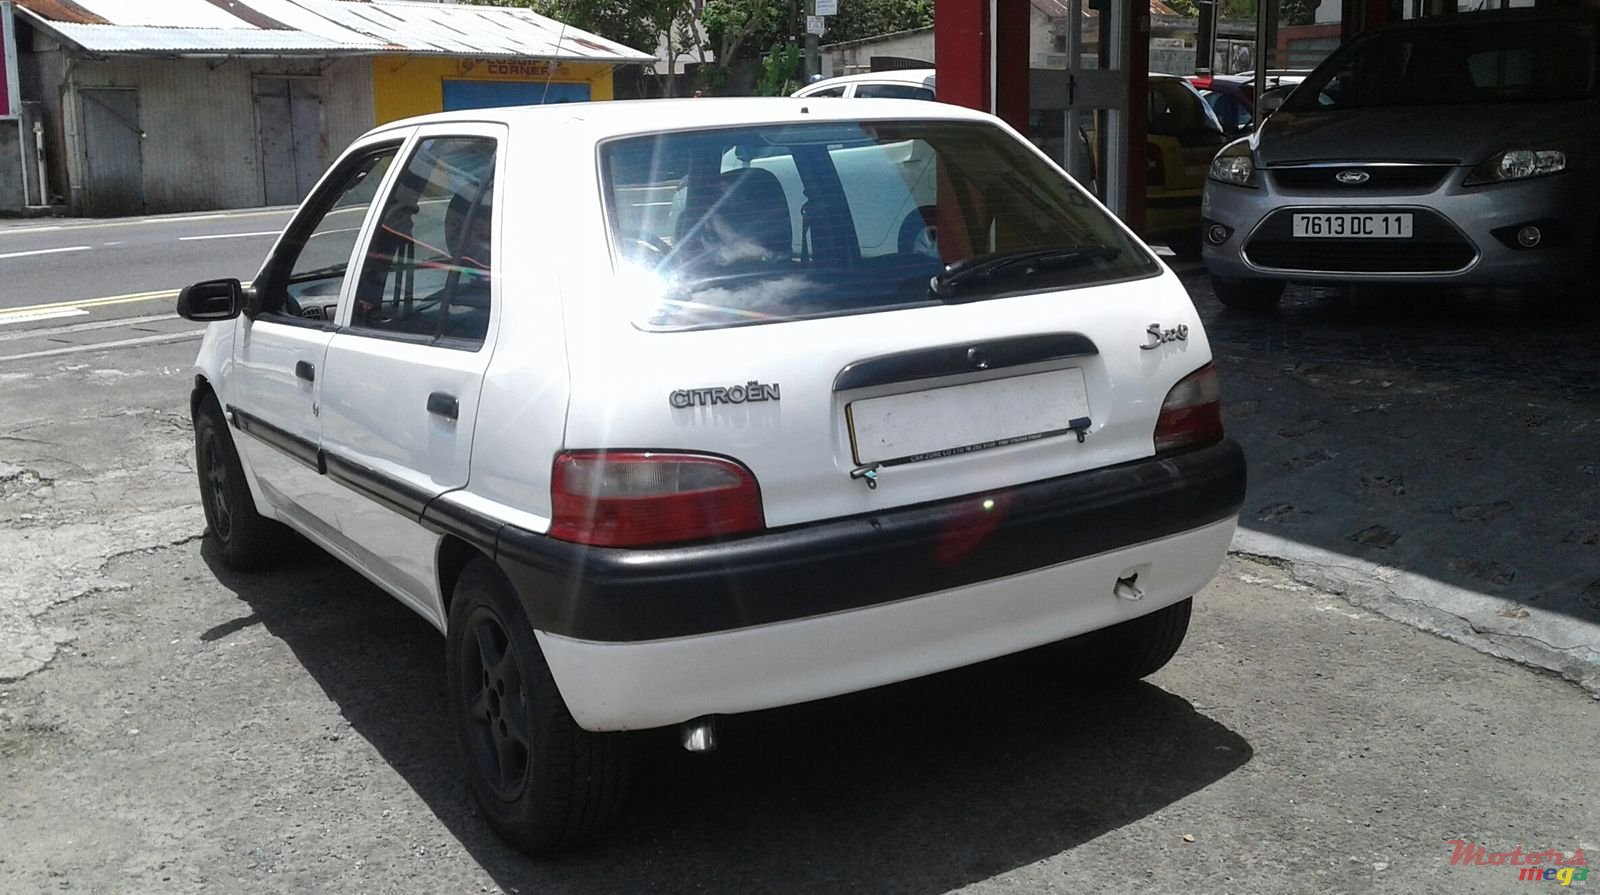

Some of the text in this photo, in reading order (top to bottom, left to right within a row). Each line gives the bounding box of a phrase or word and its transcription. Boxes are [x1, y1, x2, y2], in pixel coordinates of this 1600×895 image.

[487, 65, 551, 75] CORNER
[1342, 171, 1362, 180] Ford
[1300, 215, 1402, 235] 7613 DC 11
[669, 380, 781, 408] CITROËN
